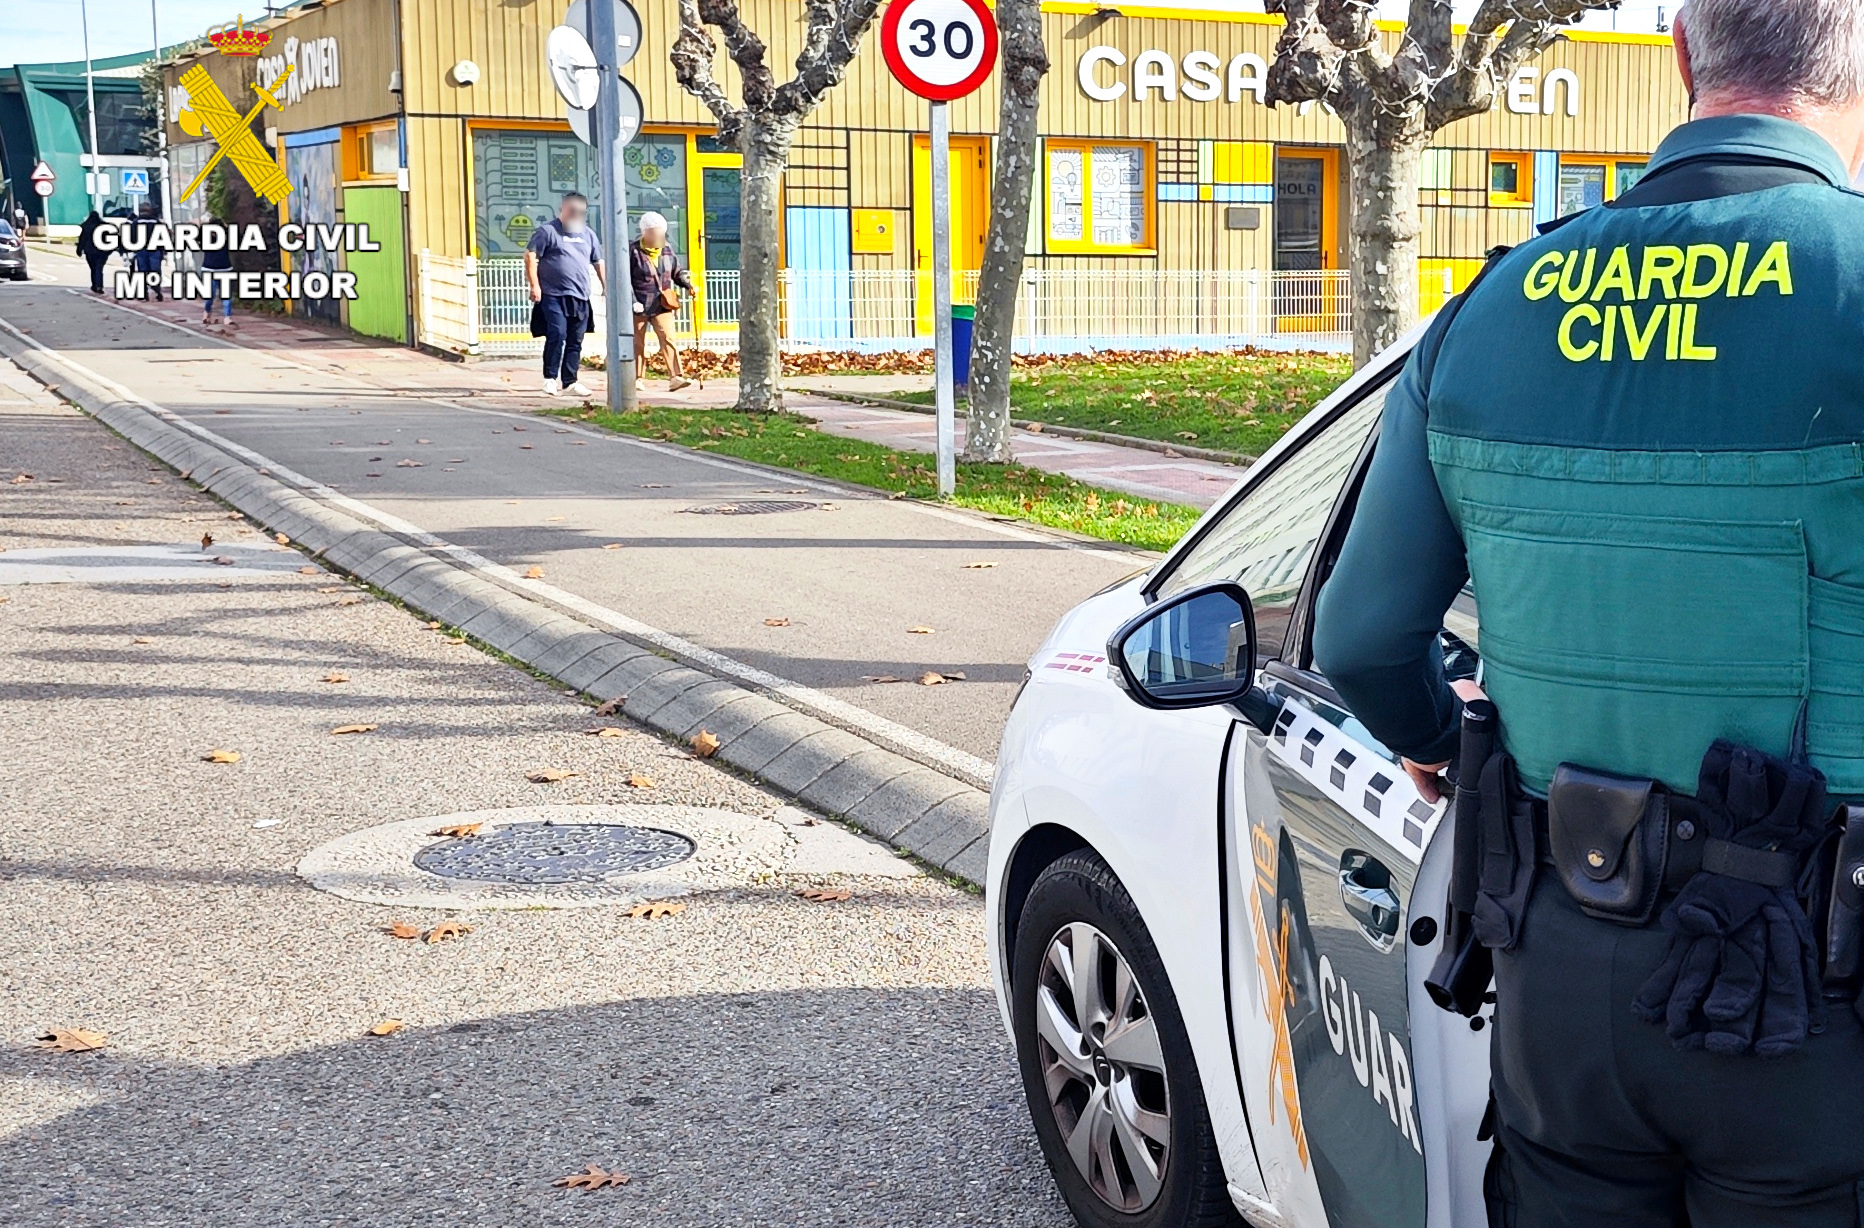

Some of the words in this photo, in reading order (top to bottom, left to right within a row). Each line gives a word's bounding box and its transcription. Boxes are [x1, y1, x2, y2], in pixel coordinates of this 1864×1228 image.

[300, 36, 340, 94] JOVEN
[908, 18, 973, 60] 30
[1078, 45, 1268, 103] CASA
[1278, 182, 1317, 195] HOLA
[1523, 240, 1794, 303] GUARDIA
[1557, 302, 1717, 362] CIVIL
